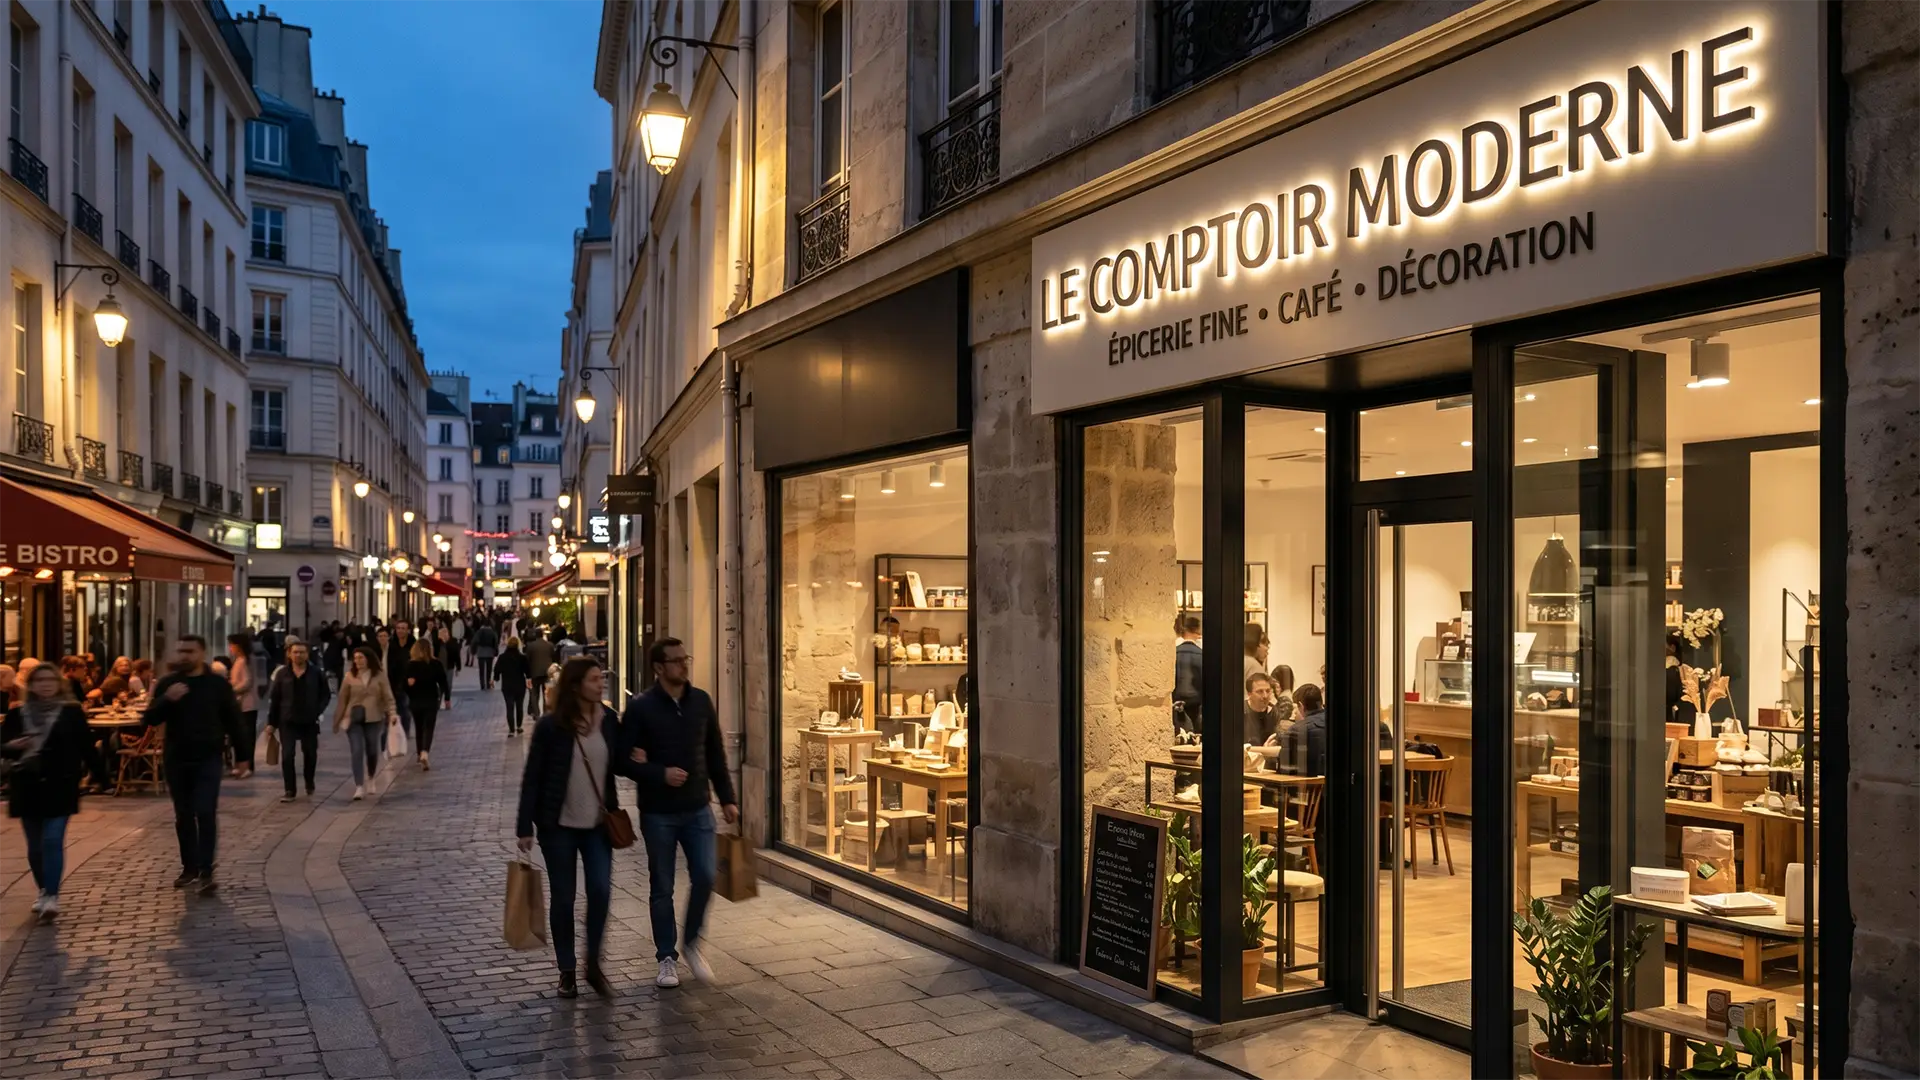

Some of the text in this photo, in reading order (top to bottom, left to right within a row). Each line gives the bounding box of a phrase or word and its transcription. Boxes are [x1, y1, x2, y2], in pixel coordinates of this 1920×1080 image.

[1042, 26, 1755, 330] LE COMPTOIR MODERNE
[1109, 211, 1594, 366] ÉPICERIE FINE CAFÉ DÉCORATION
[17, 544, 119, 565] BISTRO
